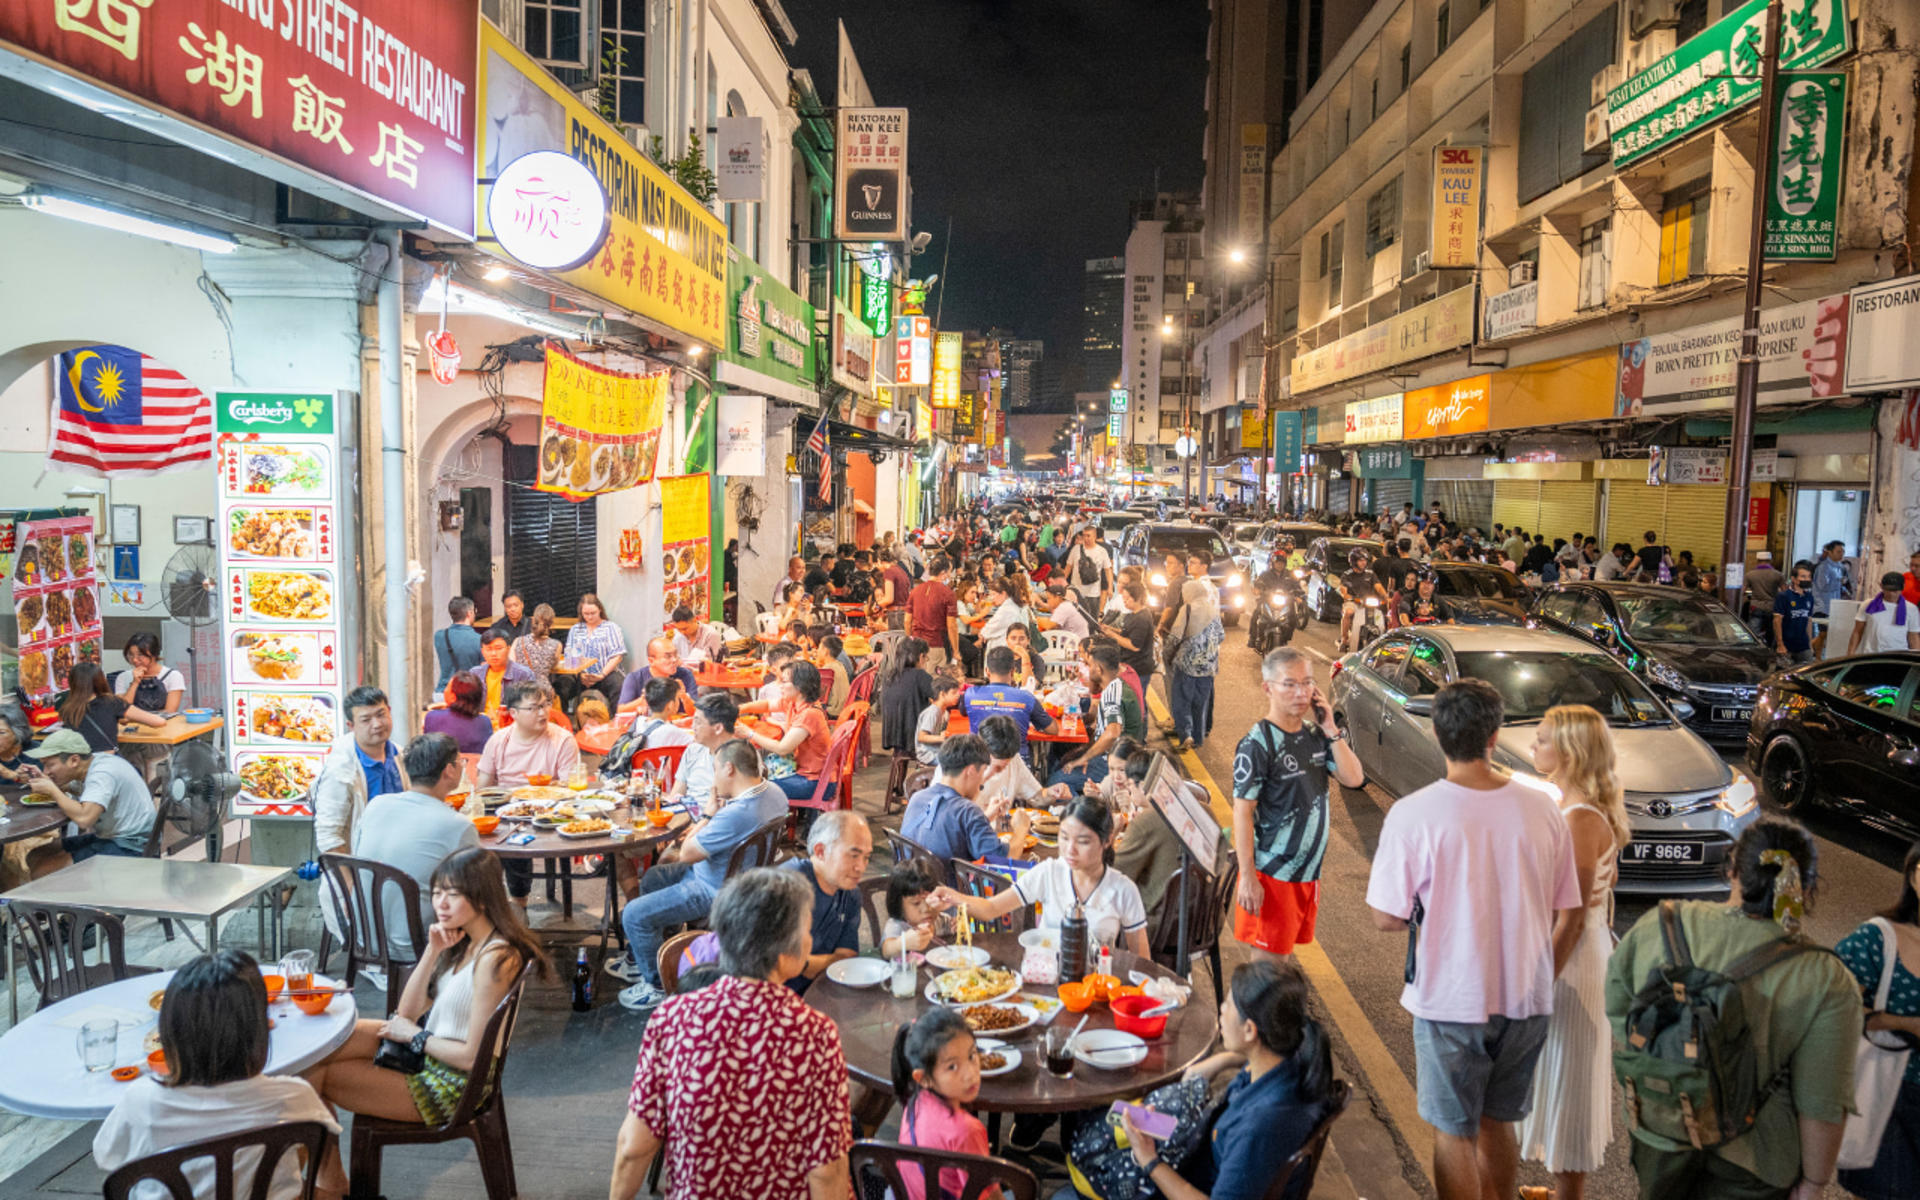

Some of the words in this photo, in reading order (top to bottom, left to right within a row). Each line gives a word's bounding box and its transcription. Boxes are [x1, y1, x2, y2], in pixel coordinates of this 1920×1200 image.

[1733, 0, 1823, 76] 李生
[280, 0, 358, 77] STREET
[362, 16, 466, 140] RESTAURANT
[1607, 84, 1629, 110] PUSAT
[1629, 55, 1677, 97] KECANTIKAN
[848, 123, 873, 132] HAN
[878, 123, 901, 132] KEE
[1442, 149, 1473, 164] SKL
[1781, 85, 1827, 205] 李先生
[572, 118, 639, 225] RESTORAN
[1443, 178, 1472, 190] KAU
[1445, 192, 1469, 204] LEE
[851, 210, 892, 220] GUINNESS
[1784, 234, 1831, 244] SINSANG
[1856, 287, 1920, 314] RESTORAN
[1681, 331, 1723, 351] BARANGAN
[1780, 316, 1806, 333] KUKU
[1655, 357, 1681, 374] BORN
[1683, 351, 1722, 370] PRETTY
[229, 400, 293, 424] Carlsberg
[120, 555, 135, 575] A
[1634, 844, 1652, 859] VF
[1655, 844, 1692, 860] 9662
